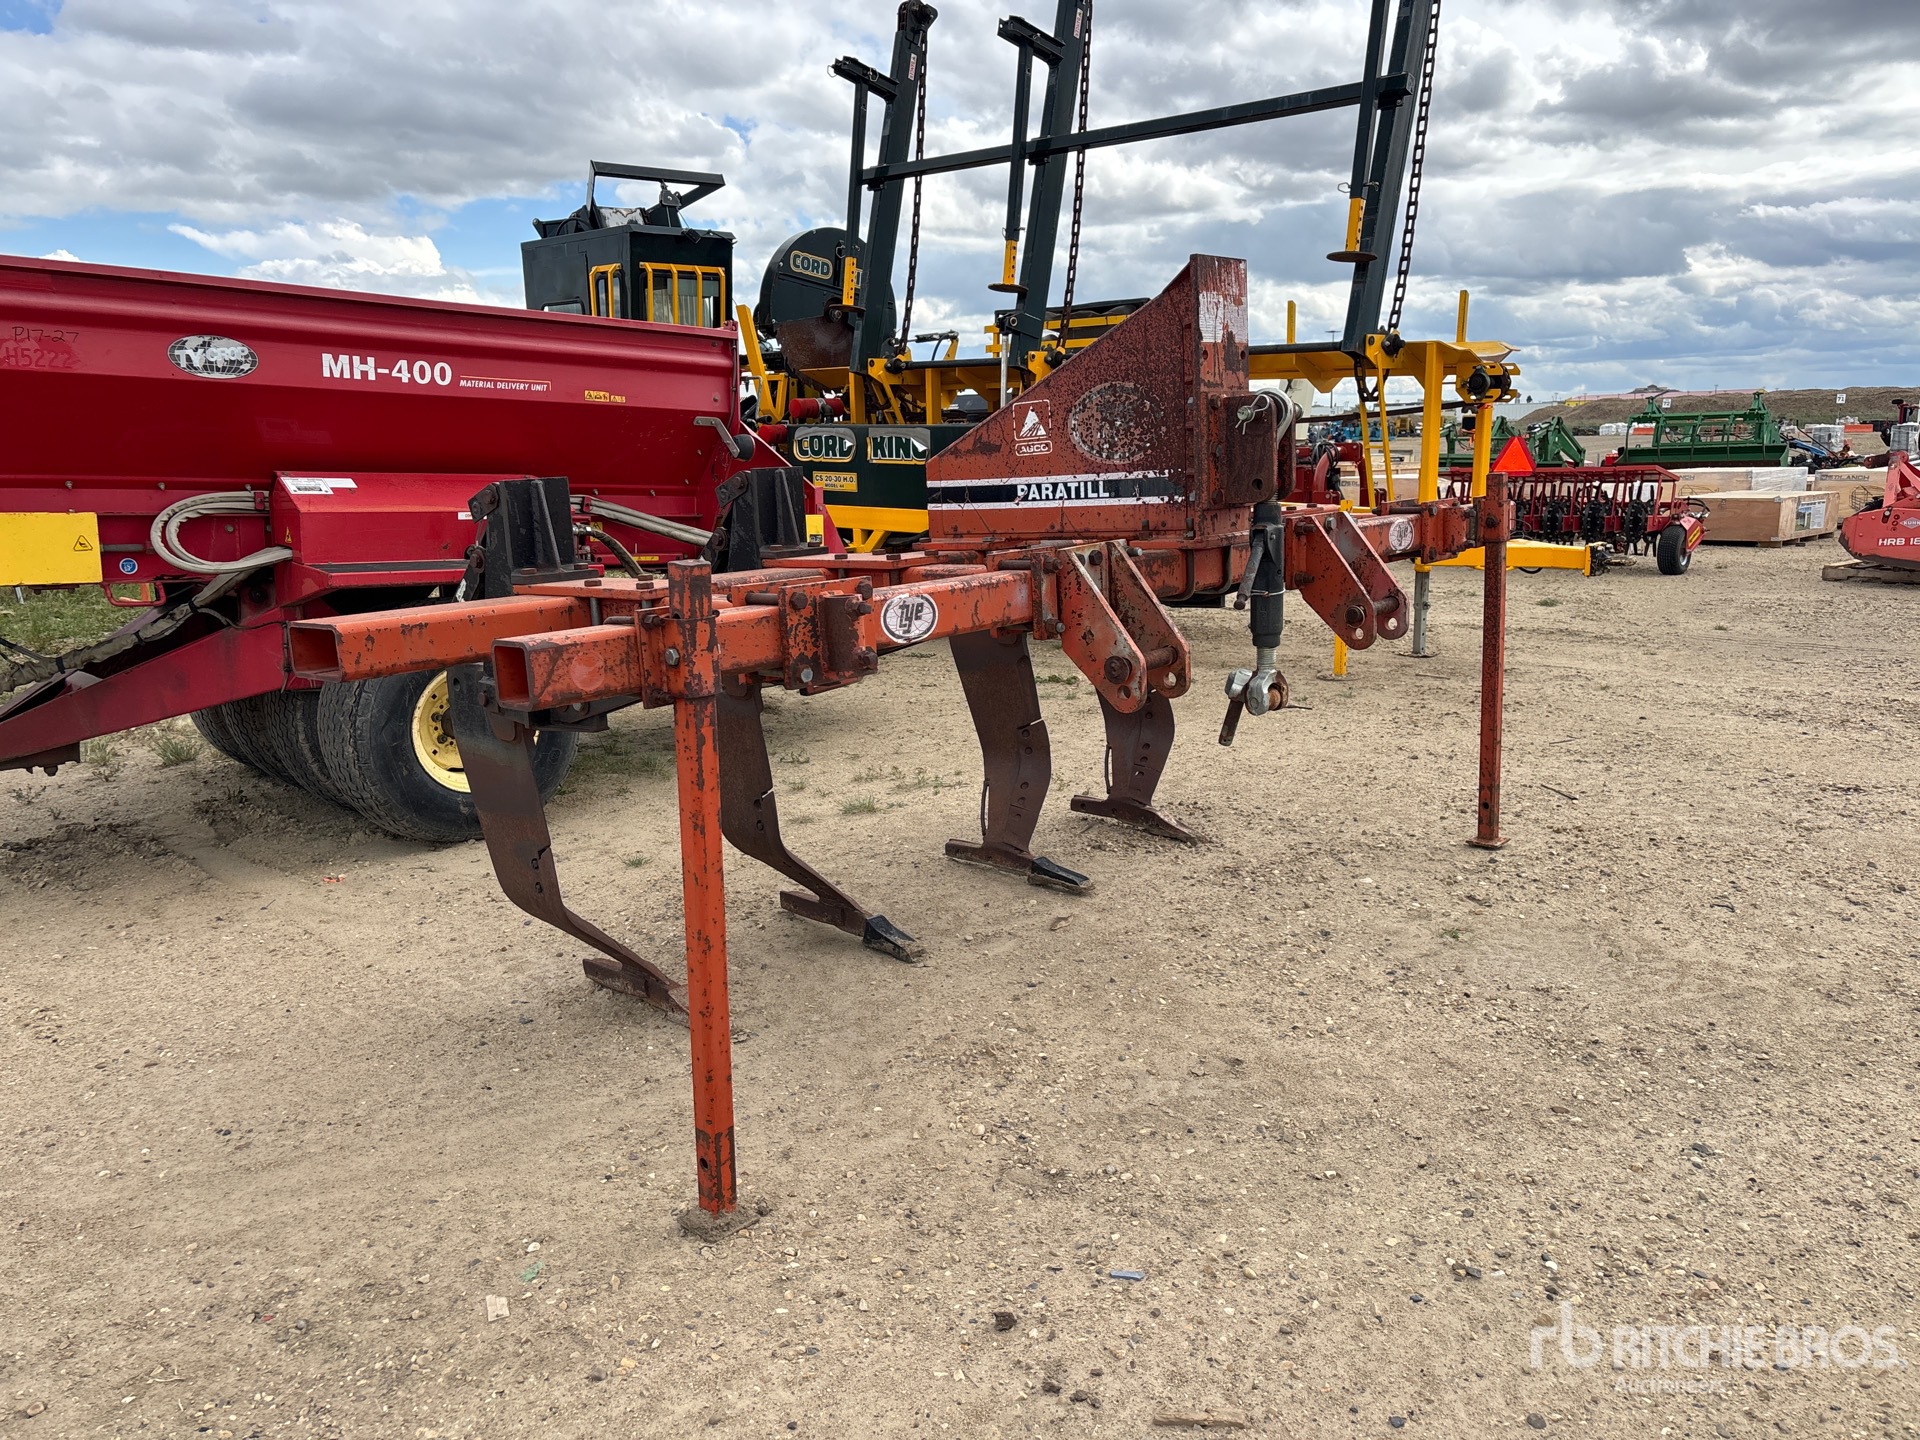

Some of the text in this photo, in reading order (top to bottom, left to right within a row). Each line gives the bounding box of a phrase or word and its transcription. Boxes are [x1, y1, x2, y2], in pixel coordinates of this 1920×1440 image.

[793, 253, 830, 276] CORD
[321, 353, 452, 386] MH-400
[459, 379, 548, 392] MATERIAL DELIVERY UNIT
[797, 435, 853, 459] CORD
[815, 474, 824, 482] CS
[824, 475, 841, 483] 20-30
[1016, 481, 1110, 501] PARATILL
[1878, 537, 1906, 546] HRB
